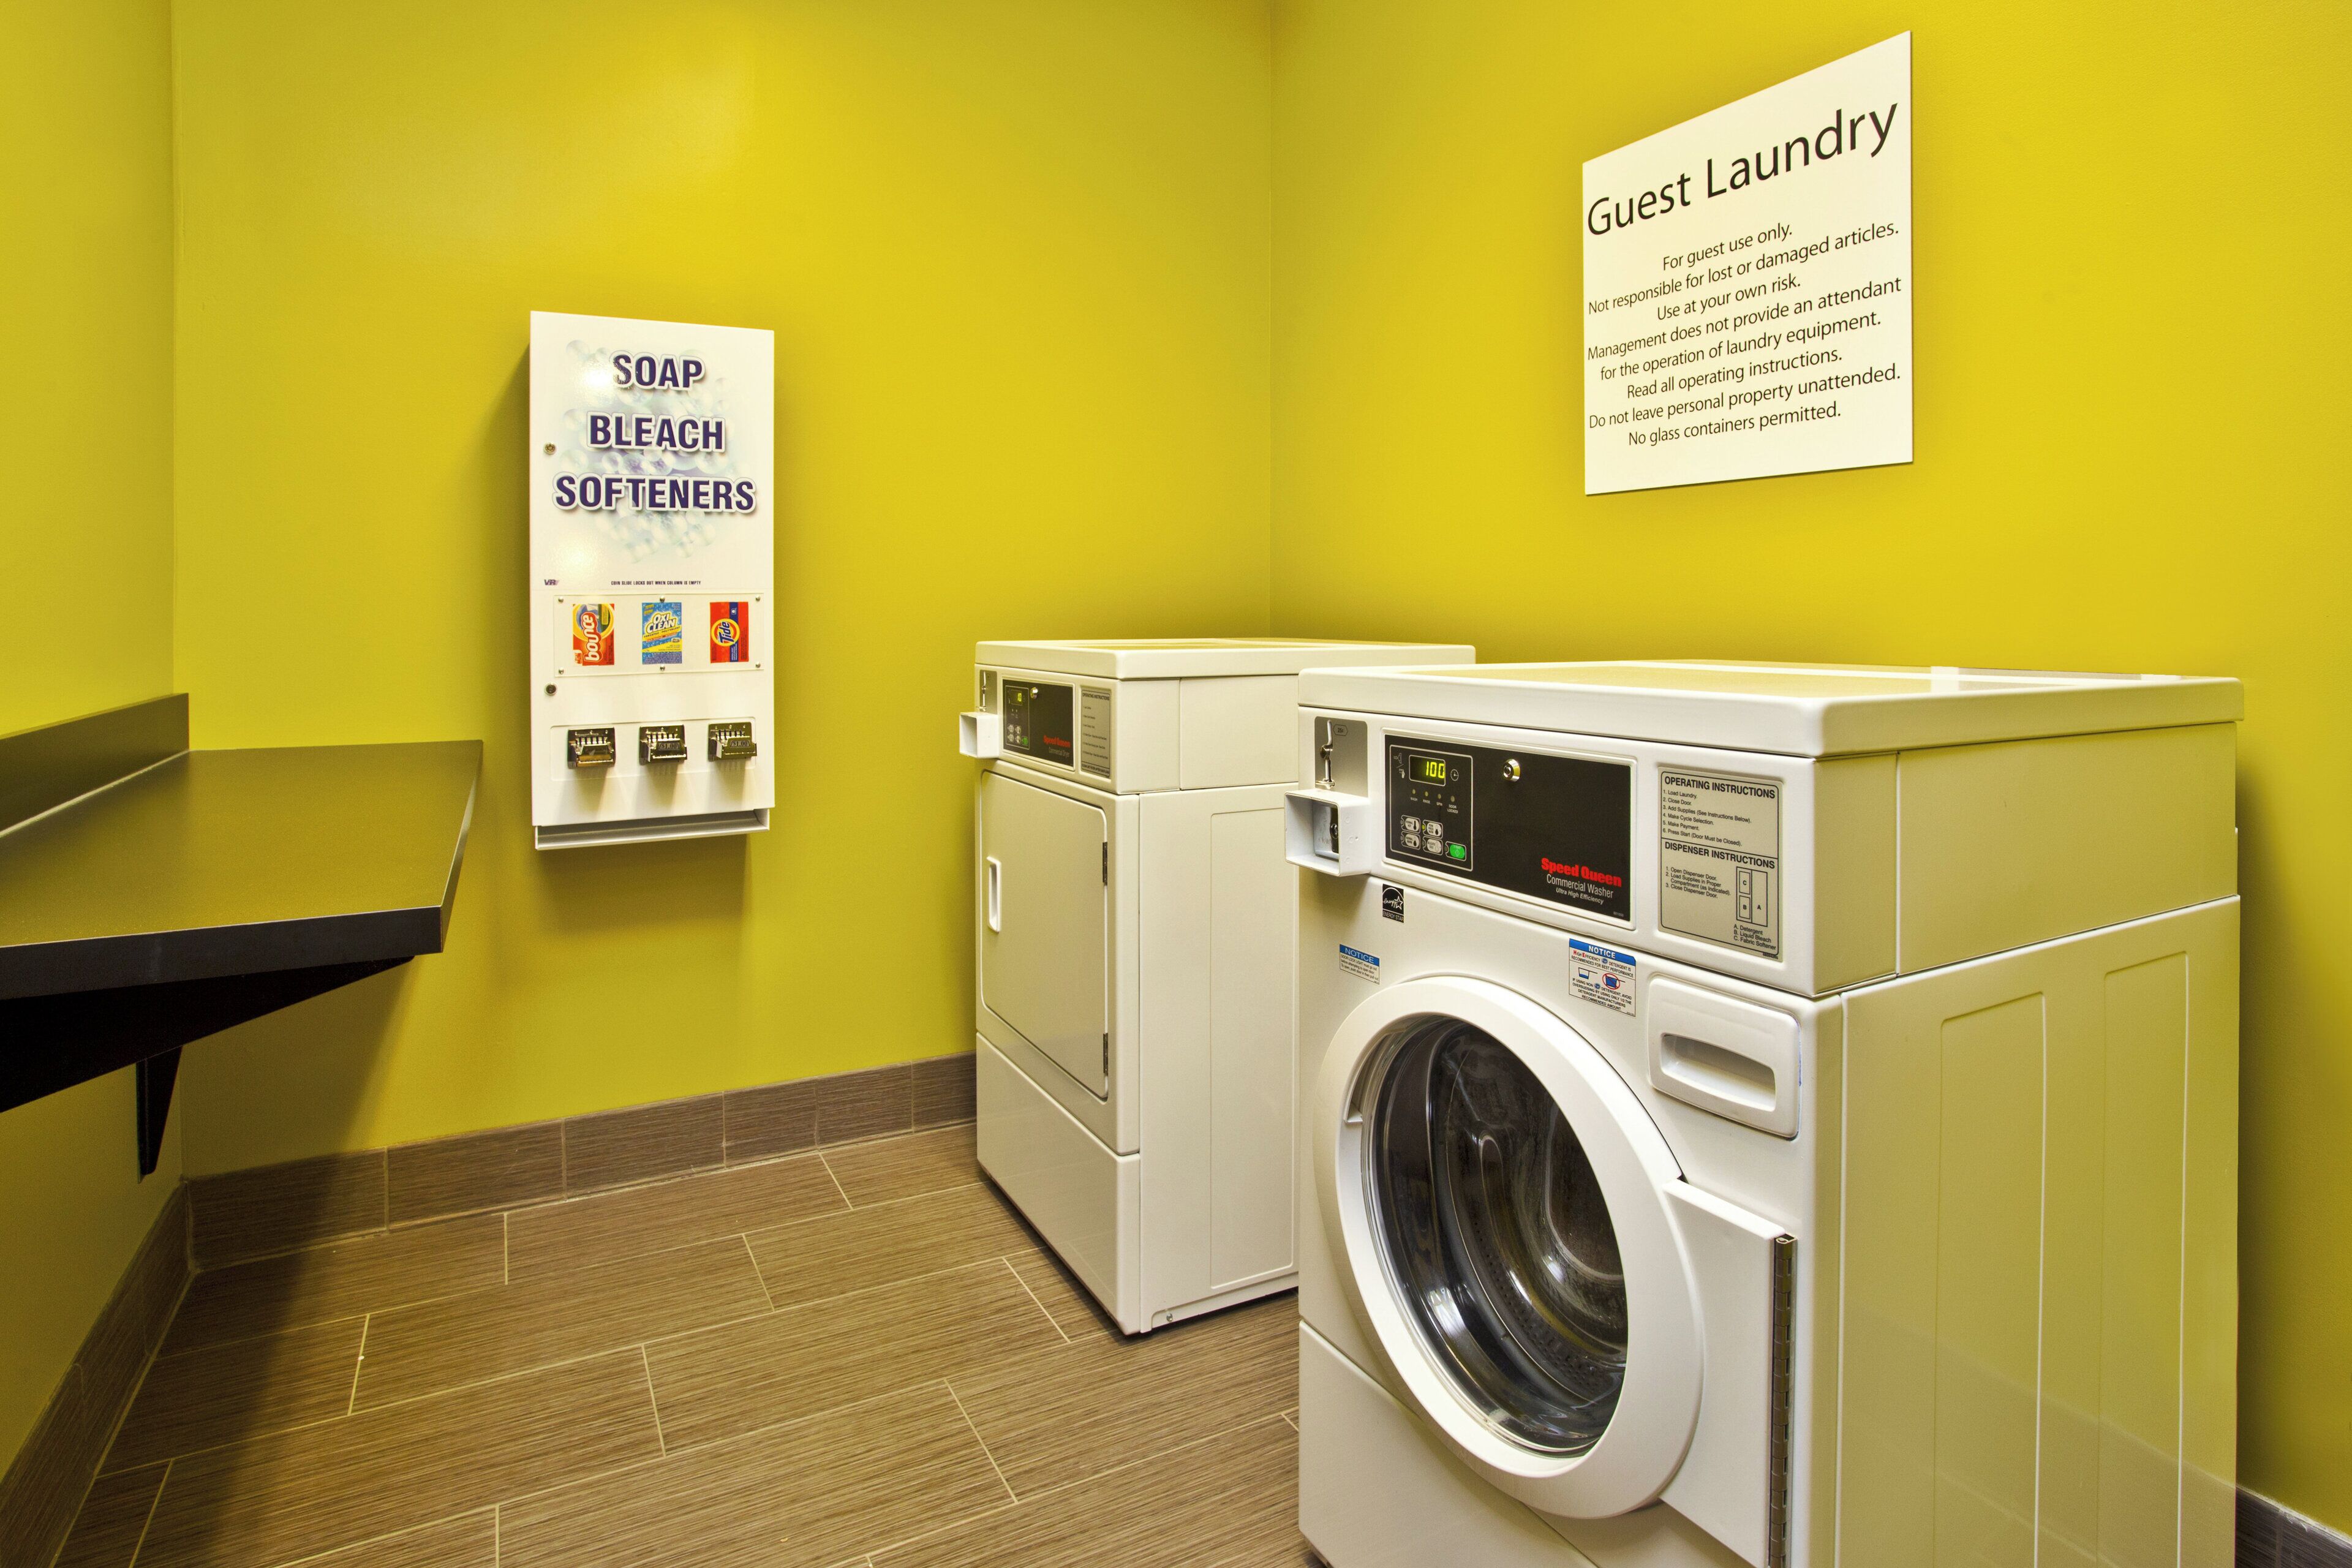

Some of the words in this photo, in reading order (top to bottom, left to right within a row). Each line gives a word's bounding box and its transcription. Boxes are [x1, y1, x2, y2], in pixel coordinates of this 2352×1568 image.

[1587, 173, 1691, 235] Guest
[1707, 102, 1898, 198] Laundry
[1663, 255, 1684, 271] For
[1687, 241, 1725, 268] guest
[1729, 235, 1753, 252] use
[1757, 222, 1792, 244] only.
[1588, 299, 1609, 314] Not
[1613, 278, 1682, 308] responsible
[1685, 273, 1705, 289] for
[1708, 265, 1733, 284] lost
[1736, 261, 1752, 275] or
[1755, 235, 1829, 270] damaged
[1834, 222, 1898, 250] articles.
[1657, 305, 1680, 320] Use
[1684, 300, 1697, 314] at
[1700, 292, 1731, 314] your
[1735, 284, 1766, 301] own
[1772, 273, 1800, 293] risk.
[1588, 331, 1667, 360] Management
[1670, 325, 1702, 342] does
[1706, 317, 1729, 334] not
[1733, 302, 1789, 332] provide
[1793, 300, 1812, 314] an
[1818, 277, 1901, 309] attendant
[1600, 366, 1617, 380] for
[1619, 361, 1640, 377] the
[1642, 349, 1705, 374] operation
[1708, 340, 1724, 358] of
[1727, 331, 1782, 355] laundry
[1786, 311, 1880, 344] equipment.
[612, 353, 704, 390] SOAP
[1627, 379, 1657, 399] Read
[1660, 375, 1674, 393] all
[1678, 367, 1744, 391] operating
[1749, 349, 1842, 377] instructions.
[1589, 415, 1605, 428] Do
[1609, 410, 1629, 425] not
[1632, 406, 1664, 421] leave
[1667, 391, 1724, 420] personal
[1728, 384, 1793, 410] property
[1798, 362, 1900, 394] unattended.
[589, 414, 724, 451] BLEACH
[1629, 431, 1646, 445] No
[1649, 427, 1680, 447] glass
[1683, 417, 1755, 438] containers
[1759, 400, 1841, 432] permitted.
[555, 475, 755, 511] SOFTENERS
[646, 619, 676, 633] CLEAN
[653, 613, 671, 624] OXI
[718, 621, 735, 644] Tide
[1426, 761, 1445, 778] 100
[1664, 775, 1710, 790] OPERATING
[1711, 782, 1776, 799] INSTRUCTIONS
[1677, 806, 1696, 815] Supplies
[1707, 812, 1733, 820] Instructions
[1734, 815, 1752, 824] Below).
[1692, 816, 1714, 825] Selection.
[1679, 822, 1700, 831] Payment.
[1722, 838, 1742, 847] Closed).
[1665, 841, 1709, 857] DISPENSER
[1711, 850, 1775, 869] INSTRUCTIONS
[1541, 858, 1580, 877] Speed
[1581, 865, 1622, 888] Queen
[1682, 875, 1700, 883] Supplies
[1683, 869, 1705, 878] Dispenser
[1547, 873, 1586, 892] Commercial
[1587, 883, 1614, 899] Washer
[1670, 878, 1699, 889] Compartment
[1708, 886, 1731, 896] Indicated).
[1683, 886, 1705, 895] Dispenser
[1568, 890, 1579, 899] High
[1580, 893, 1604, 905] Efficiency
[1740, 925, 1763, 935] Detergent
[1740, 931, 1754, 940] Liquid
[1755, 935, 1771, 943] Bleach
[1588, 945, 1616, 959] NOTICE
[1740, 936, 1755, 945] Fabric
[1755, 940, 1776, 950] Softener
[1344, 947, 1374, 964] NOTICE
